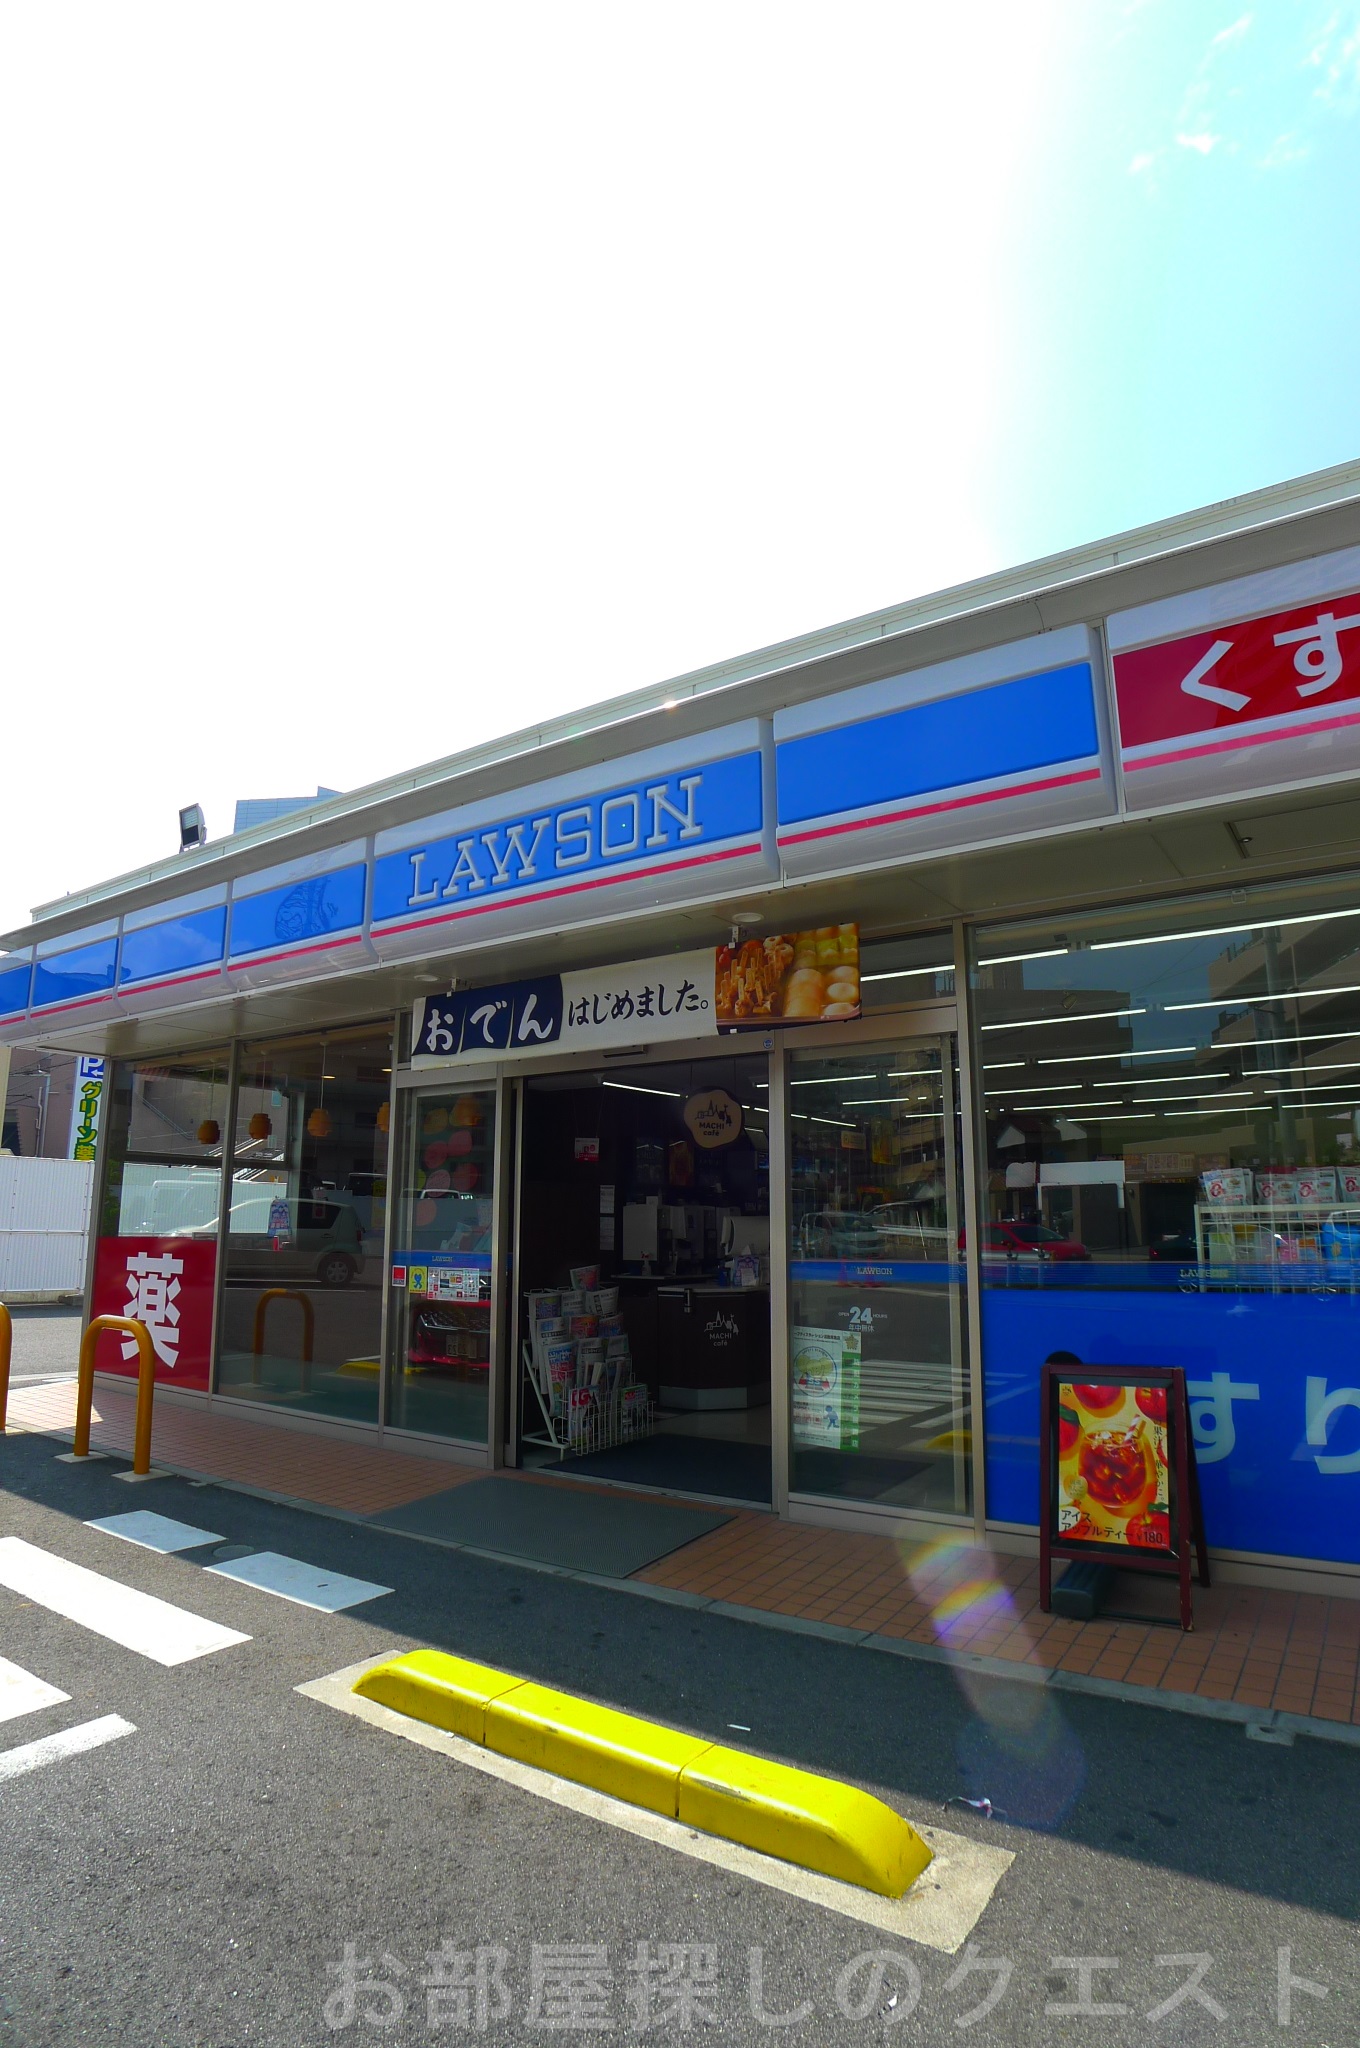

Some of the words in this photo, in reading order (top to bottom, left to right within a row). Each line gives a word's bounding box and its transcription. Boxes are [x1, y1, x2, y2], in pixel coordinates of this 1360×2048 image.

[1180, 612, 1360, 712] くす
[408, 773, 704, 906] LAWSON
[425, 993, 553, 1052] おでん
[568, 979, 709, 1028] はじめました。
[82, 1056, 104, 1073] P
[699, 1122, 725, 1130] MACHI
[703, 1129, 719, 1137] café
[857, 1266, 893, 1275] LAWSON
[120, 1252, 184, 1369] 薬
[849, 1306, 873, 1325] 24
[709, 1332, 732, 1341] MACHI
[1061, 1509, 1092, 1523] アイス
[1061, 1522, 1134, 1539] アップルティー
